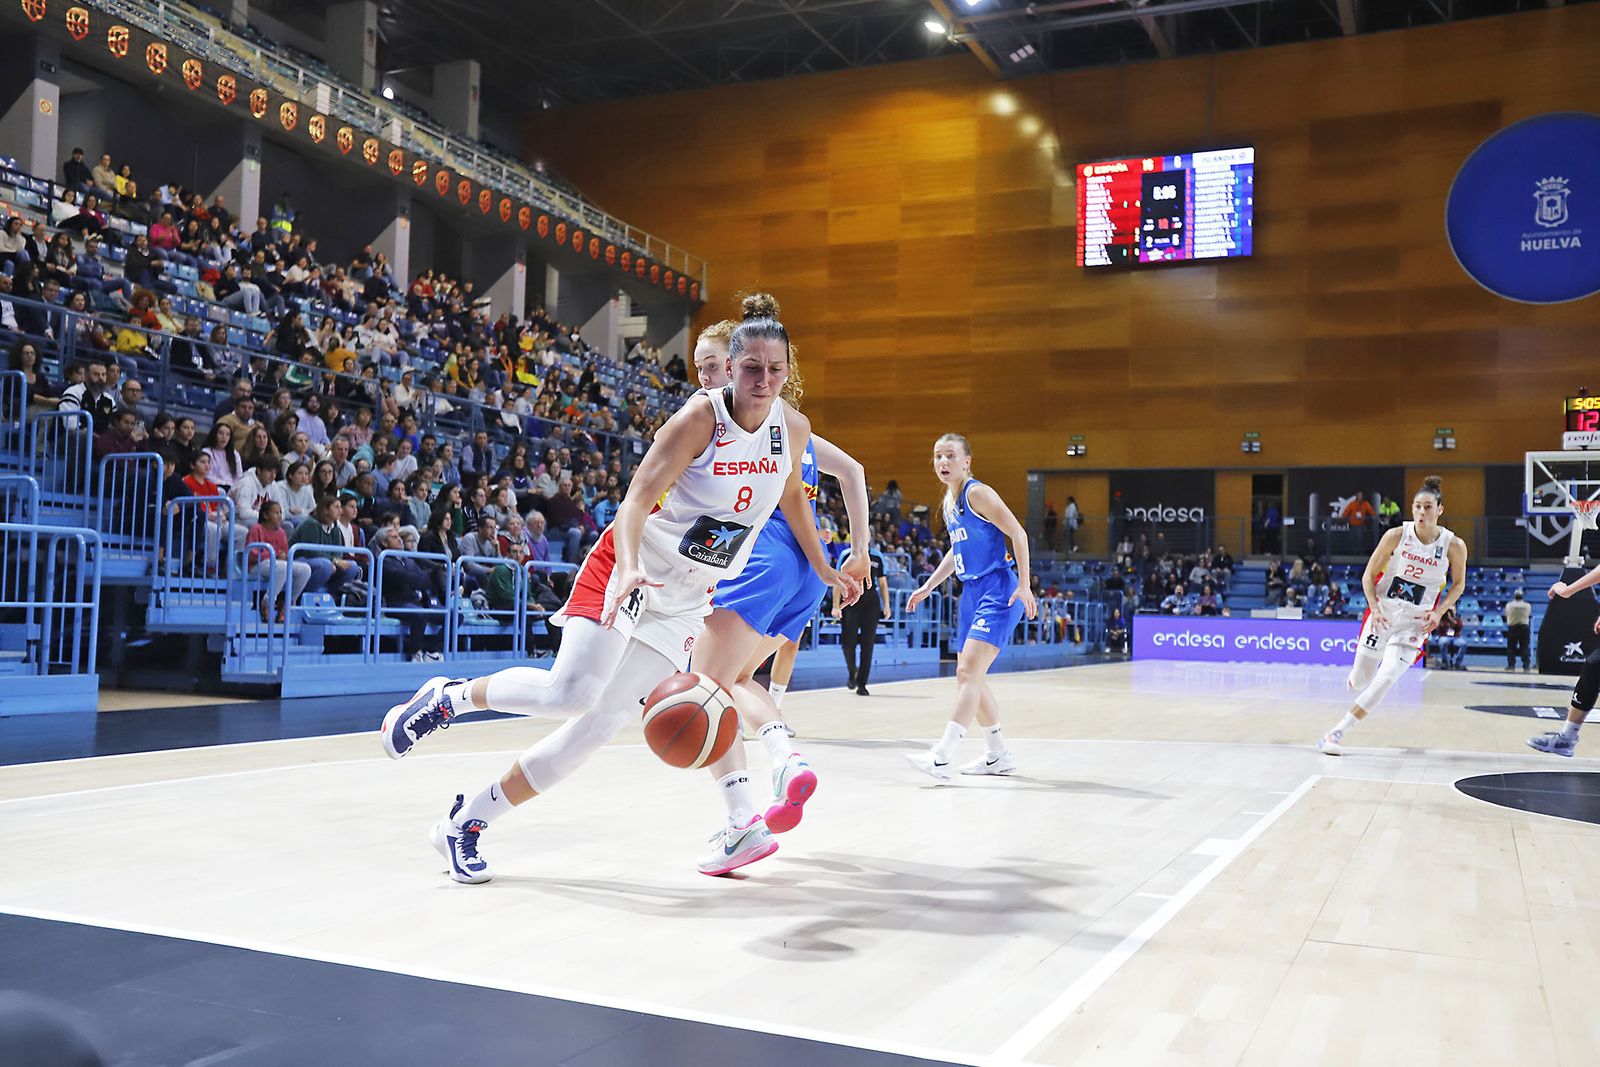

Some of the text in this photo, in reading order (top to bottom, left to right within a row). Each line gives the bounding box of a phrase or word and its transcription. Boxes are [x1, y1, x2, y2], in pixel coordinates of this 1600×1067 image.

[1521, 236, 1581, 251] HUELVA
[1577, 411, 1599, 432] 12
[713, 458, 778, 475] ESPAÑA
[733, 486, 753, 513] 8
[688, 545, 728, 566] CaixaBank
[1401, 550, 1438, 567] ESPAÑA
[1403, 564, 1424, 579] 22
[1153, 630, 1225, 648] endesa
[1234, 633, 1310, 651] endesa
